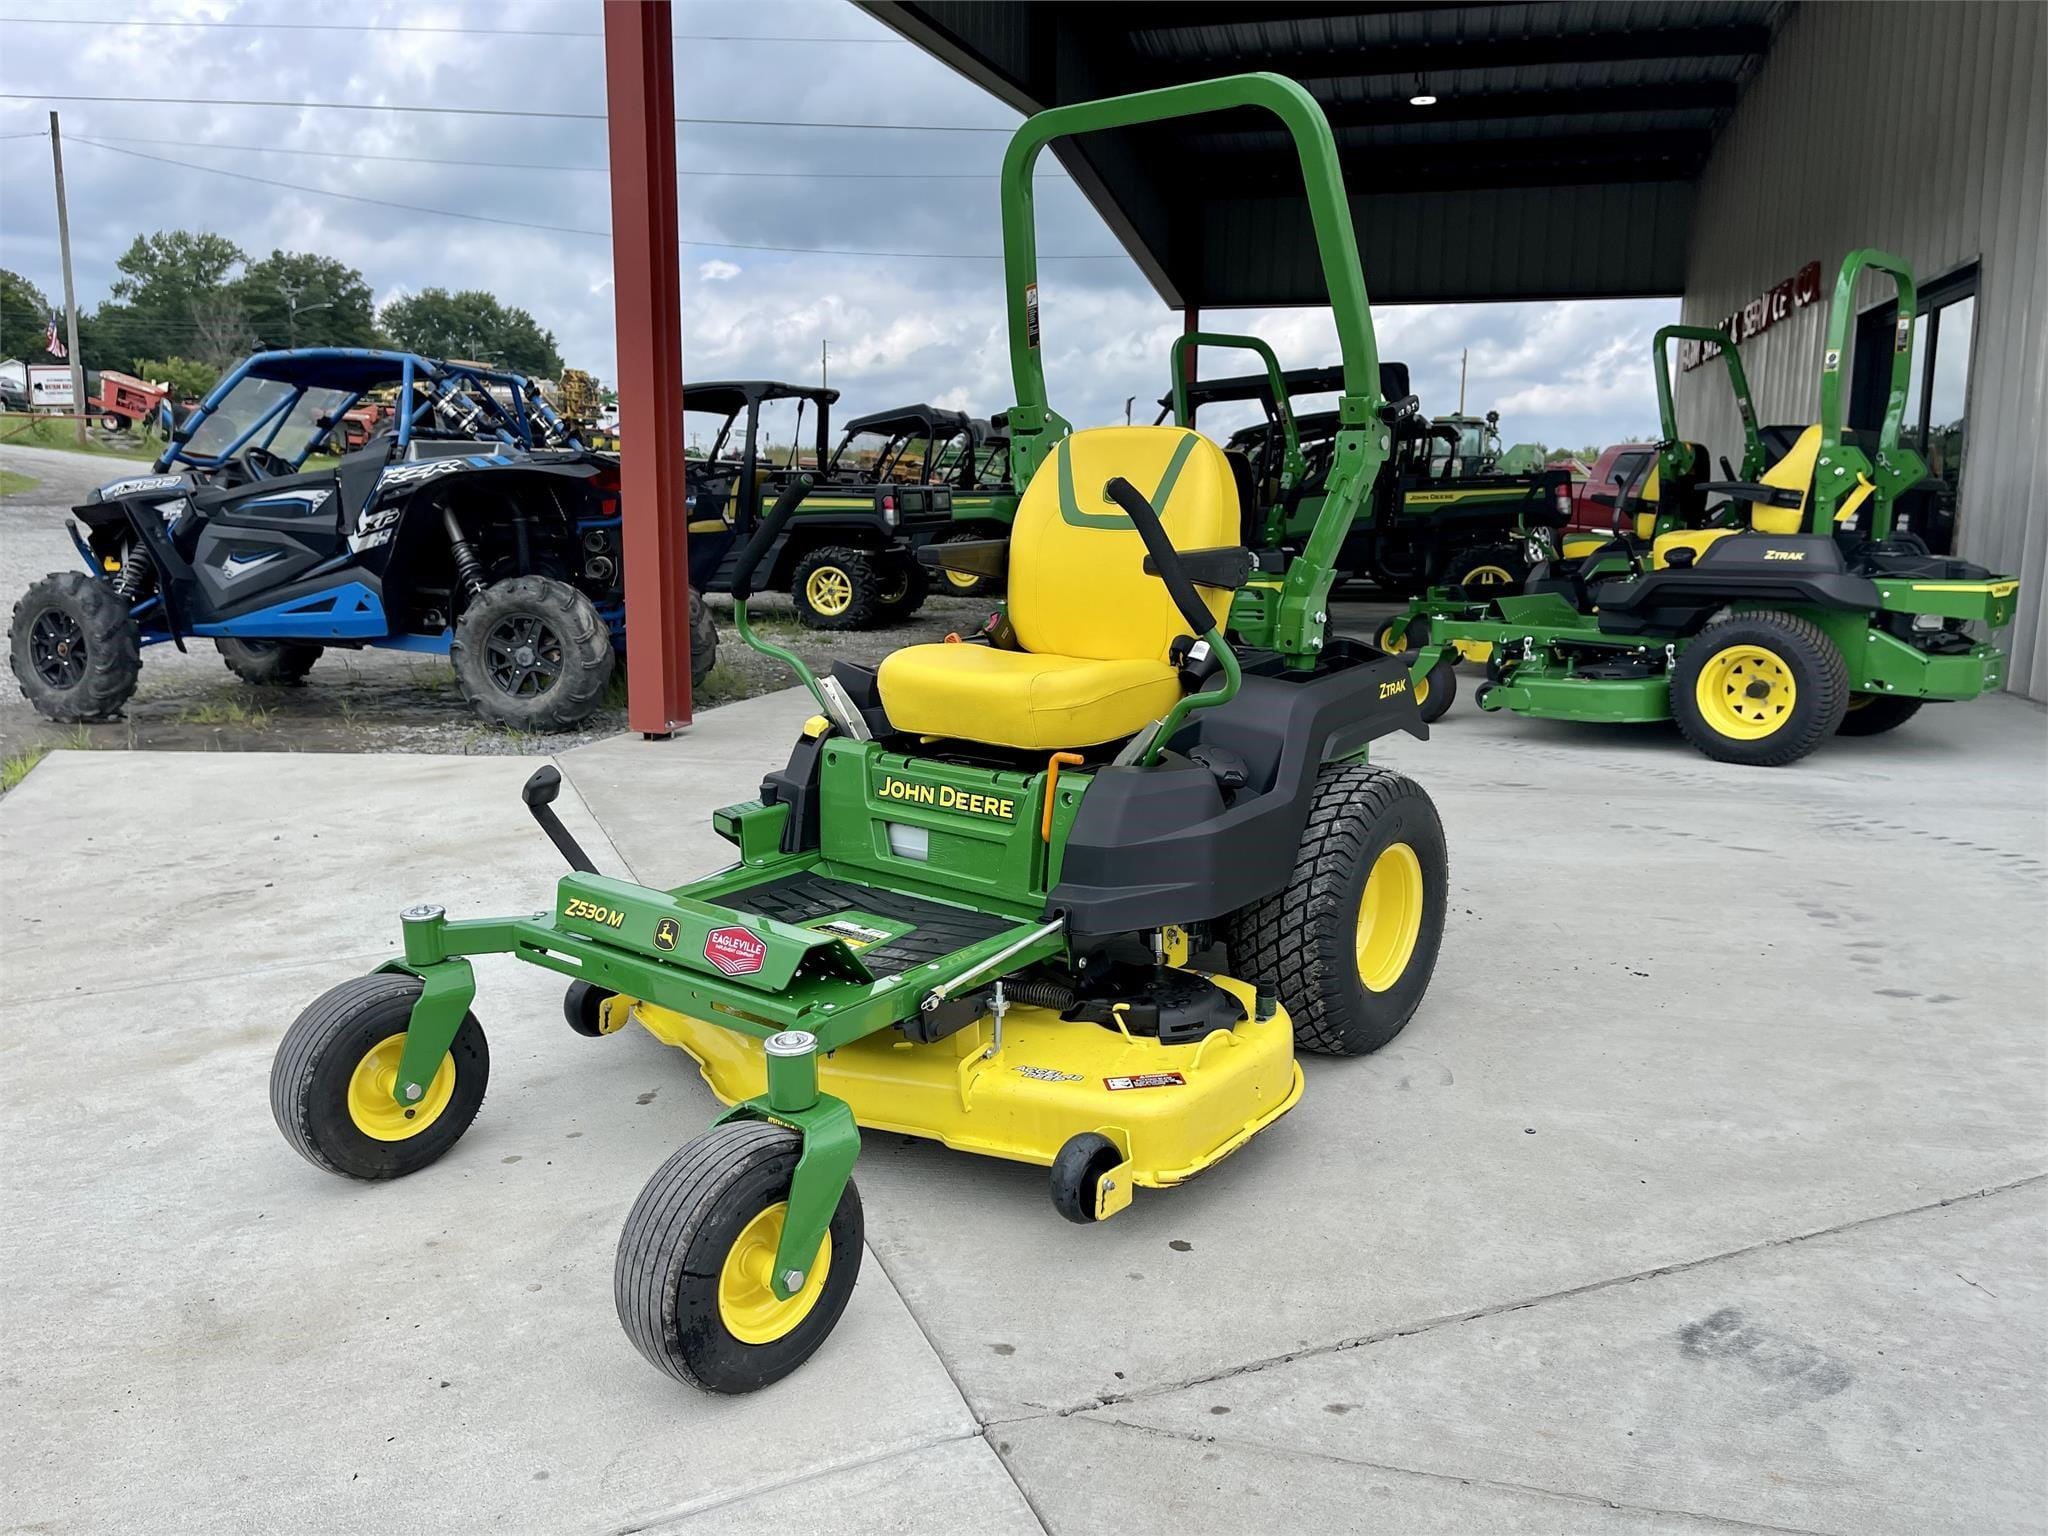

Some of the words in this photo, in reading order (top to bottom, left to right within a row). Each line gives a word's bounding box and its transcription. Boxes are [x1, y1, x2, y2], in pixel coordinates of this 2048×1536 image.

[1763, 549, 1806, 561] ZTRAK
[1379, 678, 1406, 700] ZTRAK
[878, 776, 935, 805] JOHN
[938, 785, 1014, 819] DEERE
[711, 932, 763, 955] EAGLEVILLE
